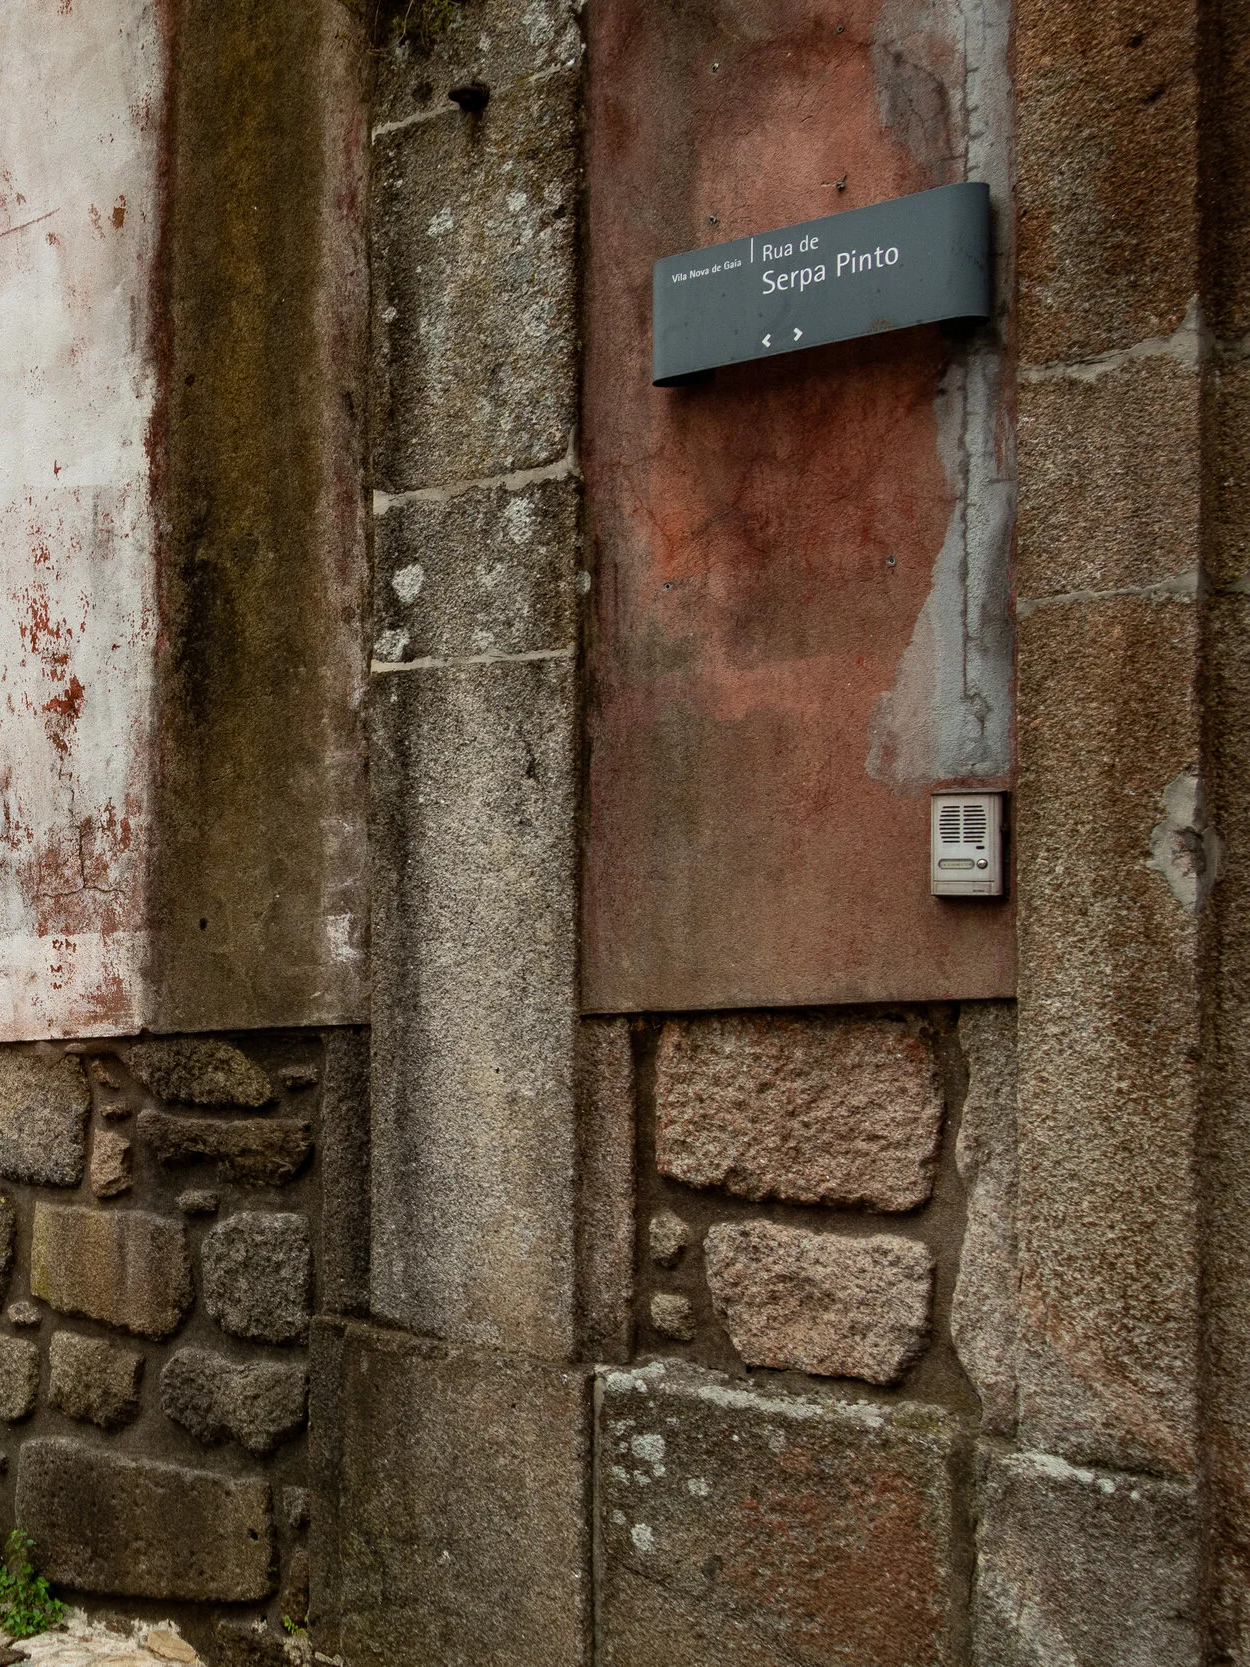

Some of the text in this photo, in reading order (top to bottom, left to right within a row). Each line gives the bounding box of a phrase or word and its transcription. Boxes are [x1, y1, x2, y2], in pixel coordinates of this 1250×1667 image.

[762, 234, 819, 262] Rua de
[671, 258, 742, 283] Vila Nova de Gaia
[762, 246, 899, 295] Serpa Pinto
